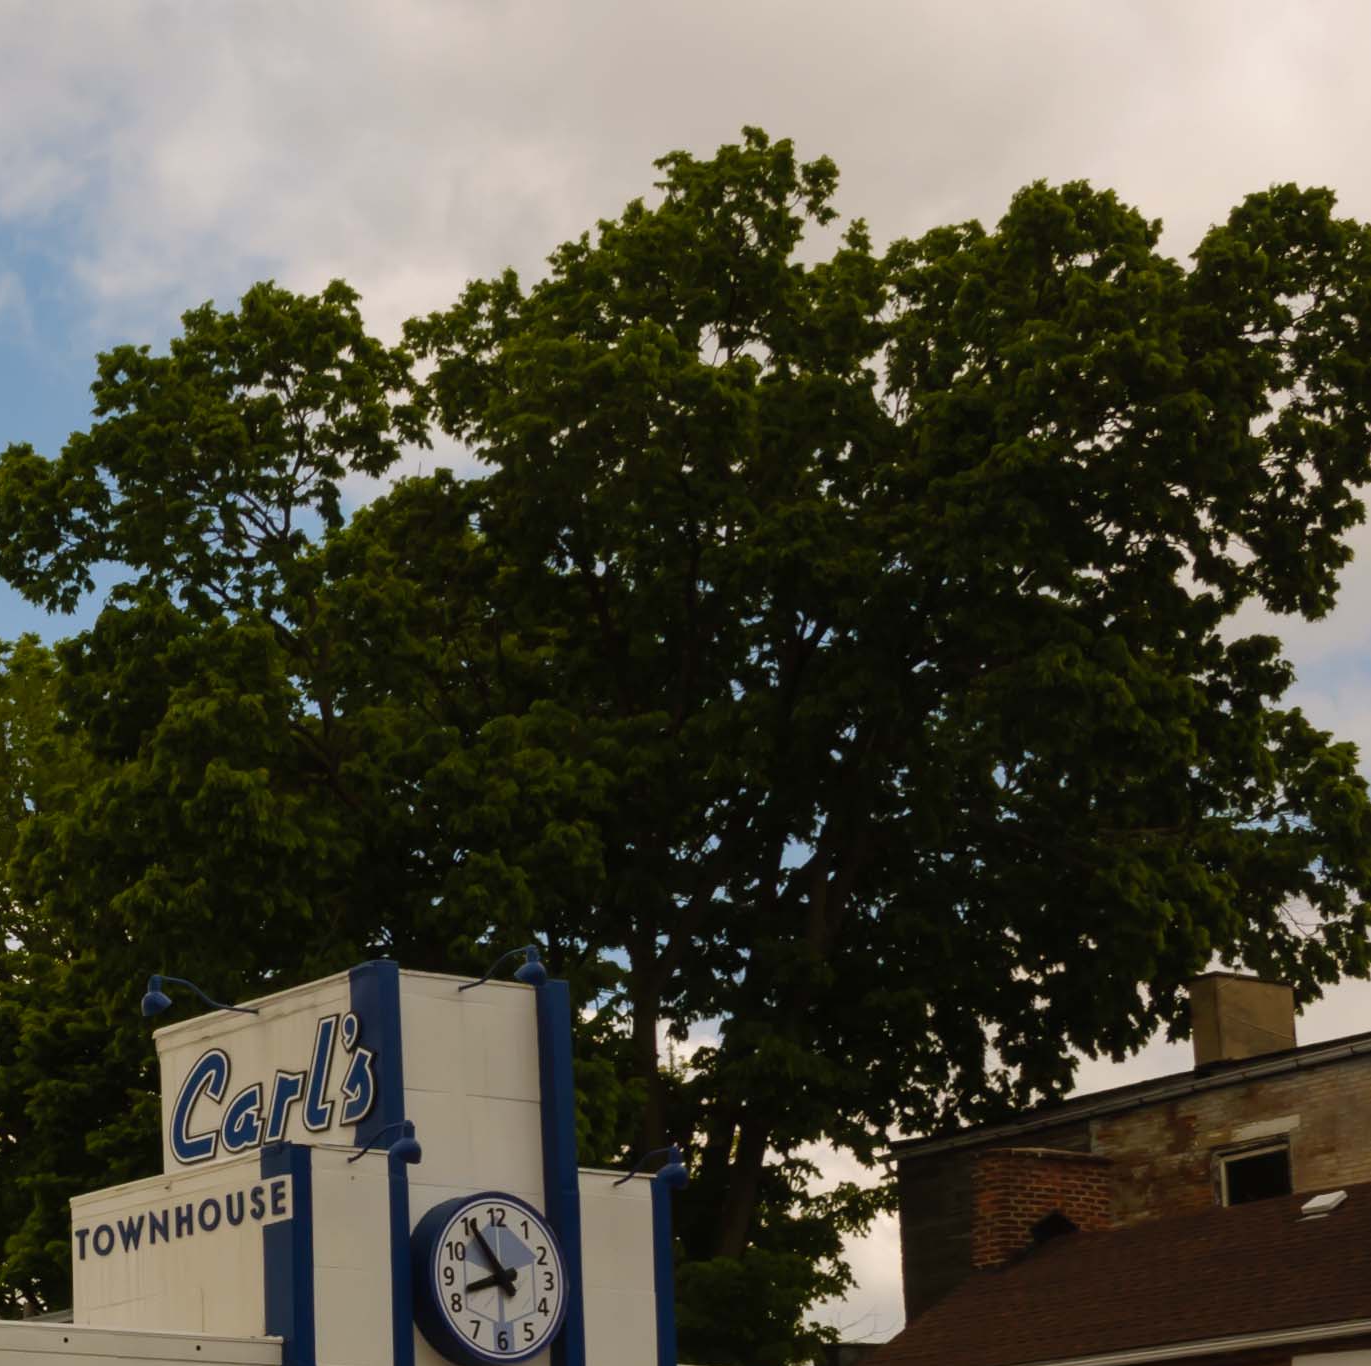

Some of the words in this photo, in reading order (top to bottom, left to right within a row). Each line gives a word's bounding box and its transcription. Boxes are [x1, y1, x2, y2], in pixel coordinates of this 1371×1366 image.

[170, 1012, 378, 1165] Carl's
[74, 1180, 287, 1260] TOWNHOUSE
[486, 1208, 507, 1228] 12
[520, 1220, 529, 1240] 1
[445, 1241, 466, 1261] 10
[536, 1246, 547, 1265] 2
[443, 1266, 455, 1286] 9
[543, 1271, 554, 1291] 3
[451, 1293, 462, 1313] 8
[537, 1297, 549, 1317] 4
[469, 1320, 481, 1340] 7
[523, 1322, 534, 1341] 5
[497, 1331, 508, 1351] 6
